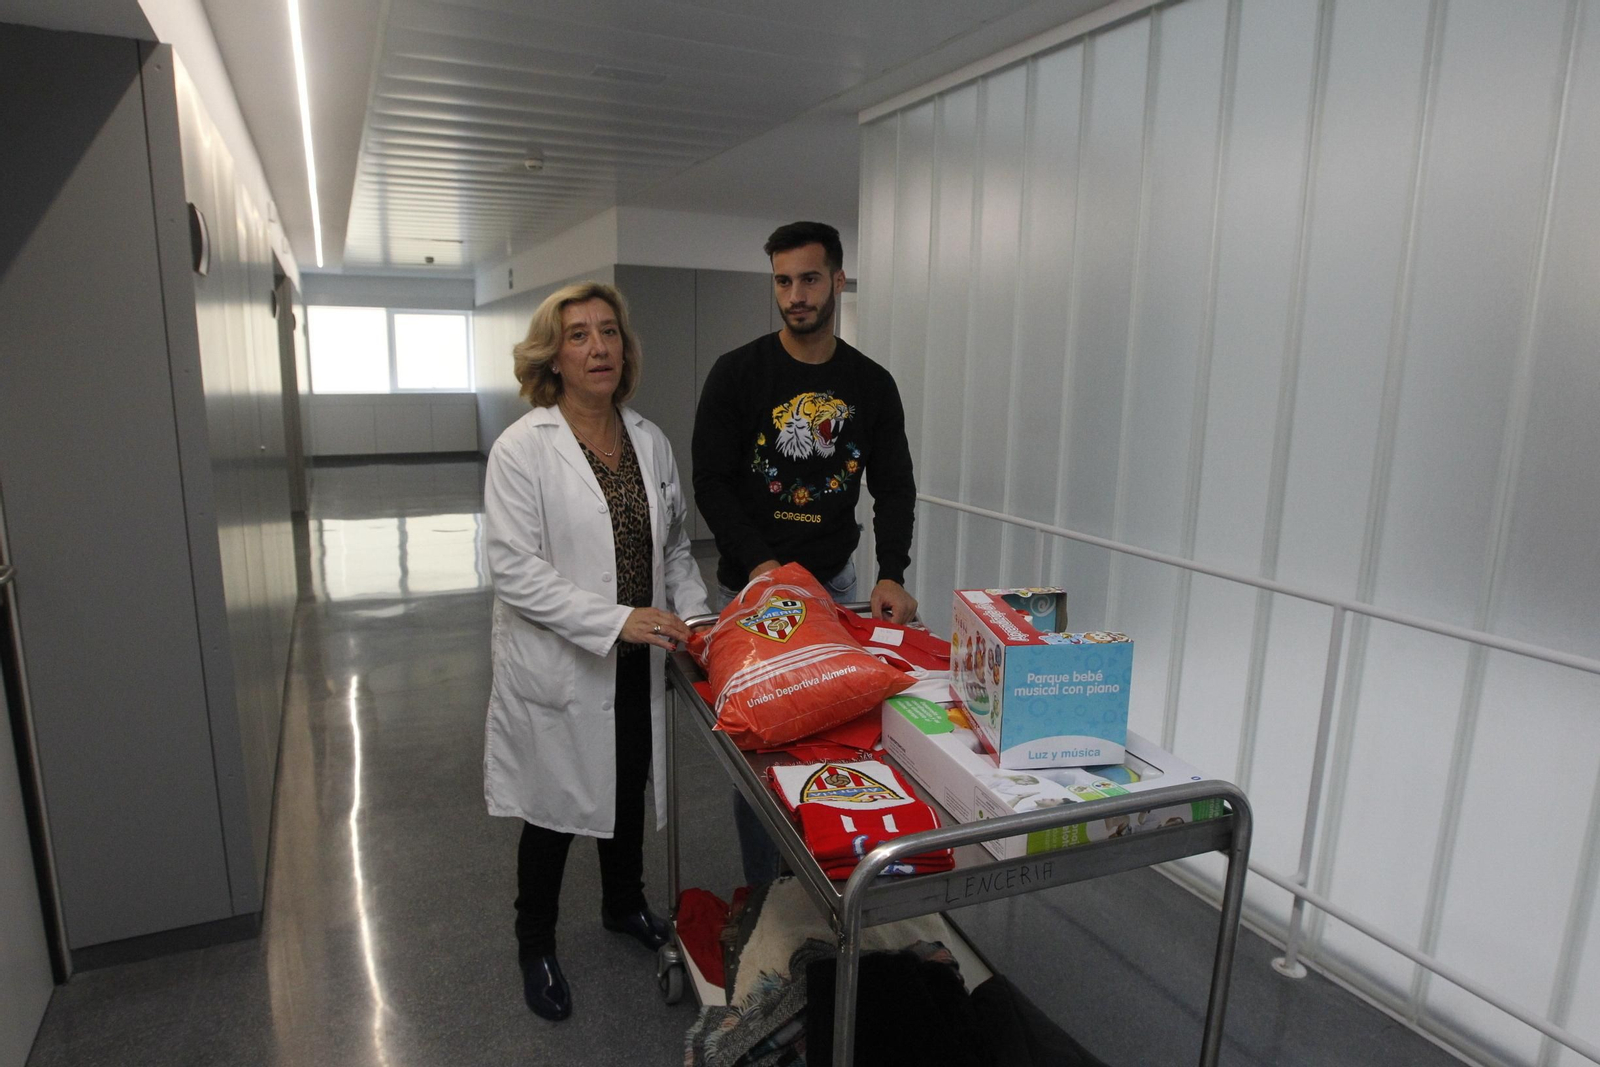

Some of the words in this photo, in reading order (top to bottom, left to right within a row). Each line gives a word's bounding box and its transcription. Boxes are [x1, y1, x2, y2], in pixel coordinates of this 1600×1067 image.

[773, 510, 822, 524] GORGEOUS
[1027, 672, 1069, 685] Parque
[1073, 669, 1104, 682] bebé
[746, 693, 775, 708] Unión
[775, 676, 820, 697] Deportiva
[821, 664, 857, 682] Almería
[1014, 684, 1059, 697] musical
[1062, 685, 1084, 695] con
[1086, 682, 1120, 696] piano
[1028, 750, 1048, 760] Luz
[1051, 751, 1058, 761] y
[1061, 748, 1101, 759] música
[944, 862, 1054, 903] LENCERIA
